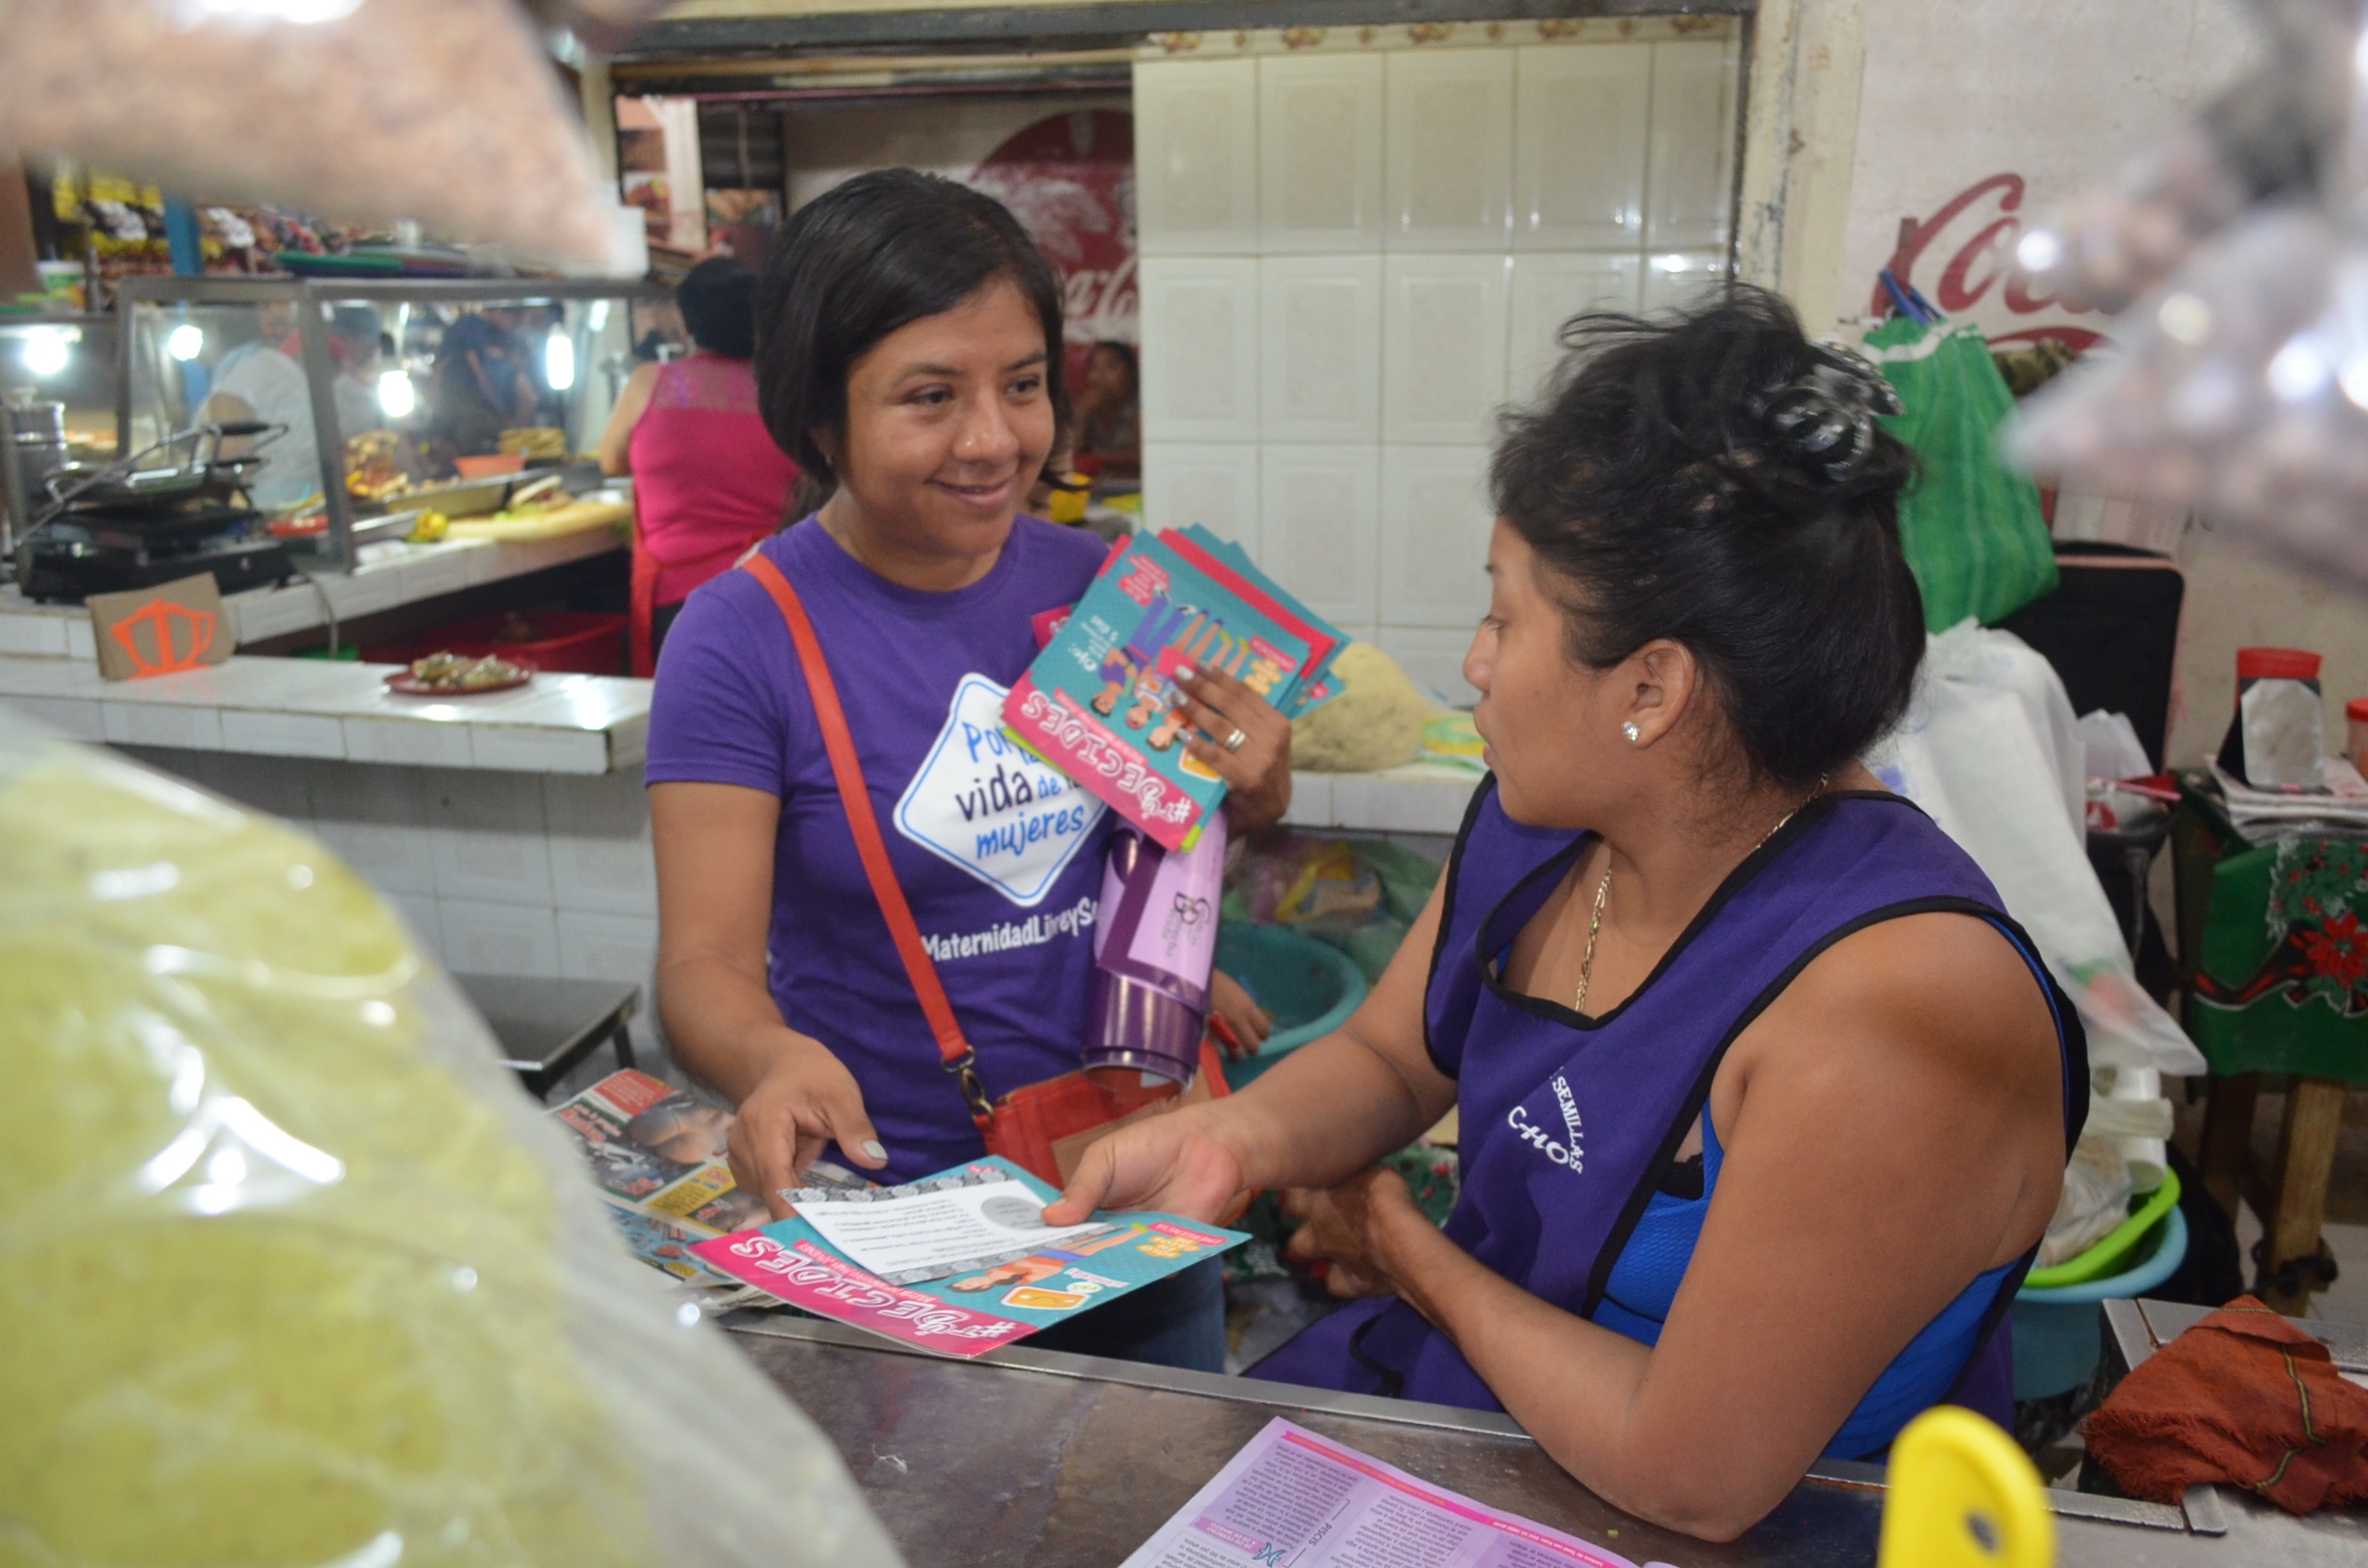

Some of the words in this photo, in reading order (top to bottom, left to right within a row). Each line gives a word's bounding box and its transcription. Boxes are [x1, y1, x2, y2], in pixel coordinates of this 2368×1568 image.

[955, 764, 1032, 821] vida
[1038, 775, 1062, 798] de
[975, 804, 1085, 860] mujeres
[1552, 1076, 1585, 1174] SEMILLAS
[1154, 1222, 1222, 1245] EMERGENCIA
[1308, 1522, 1331, 1546] PISCIS
